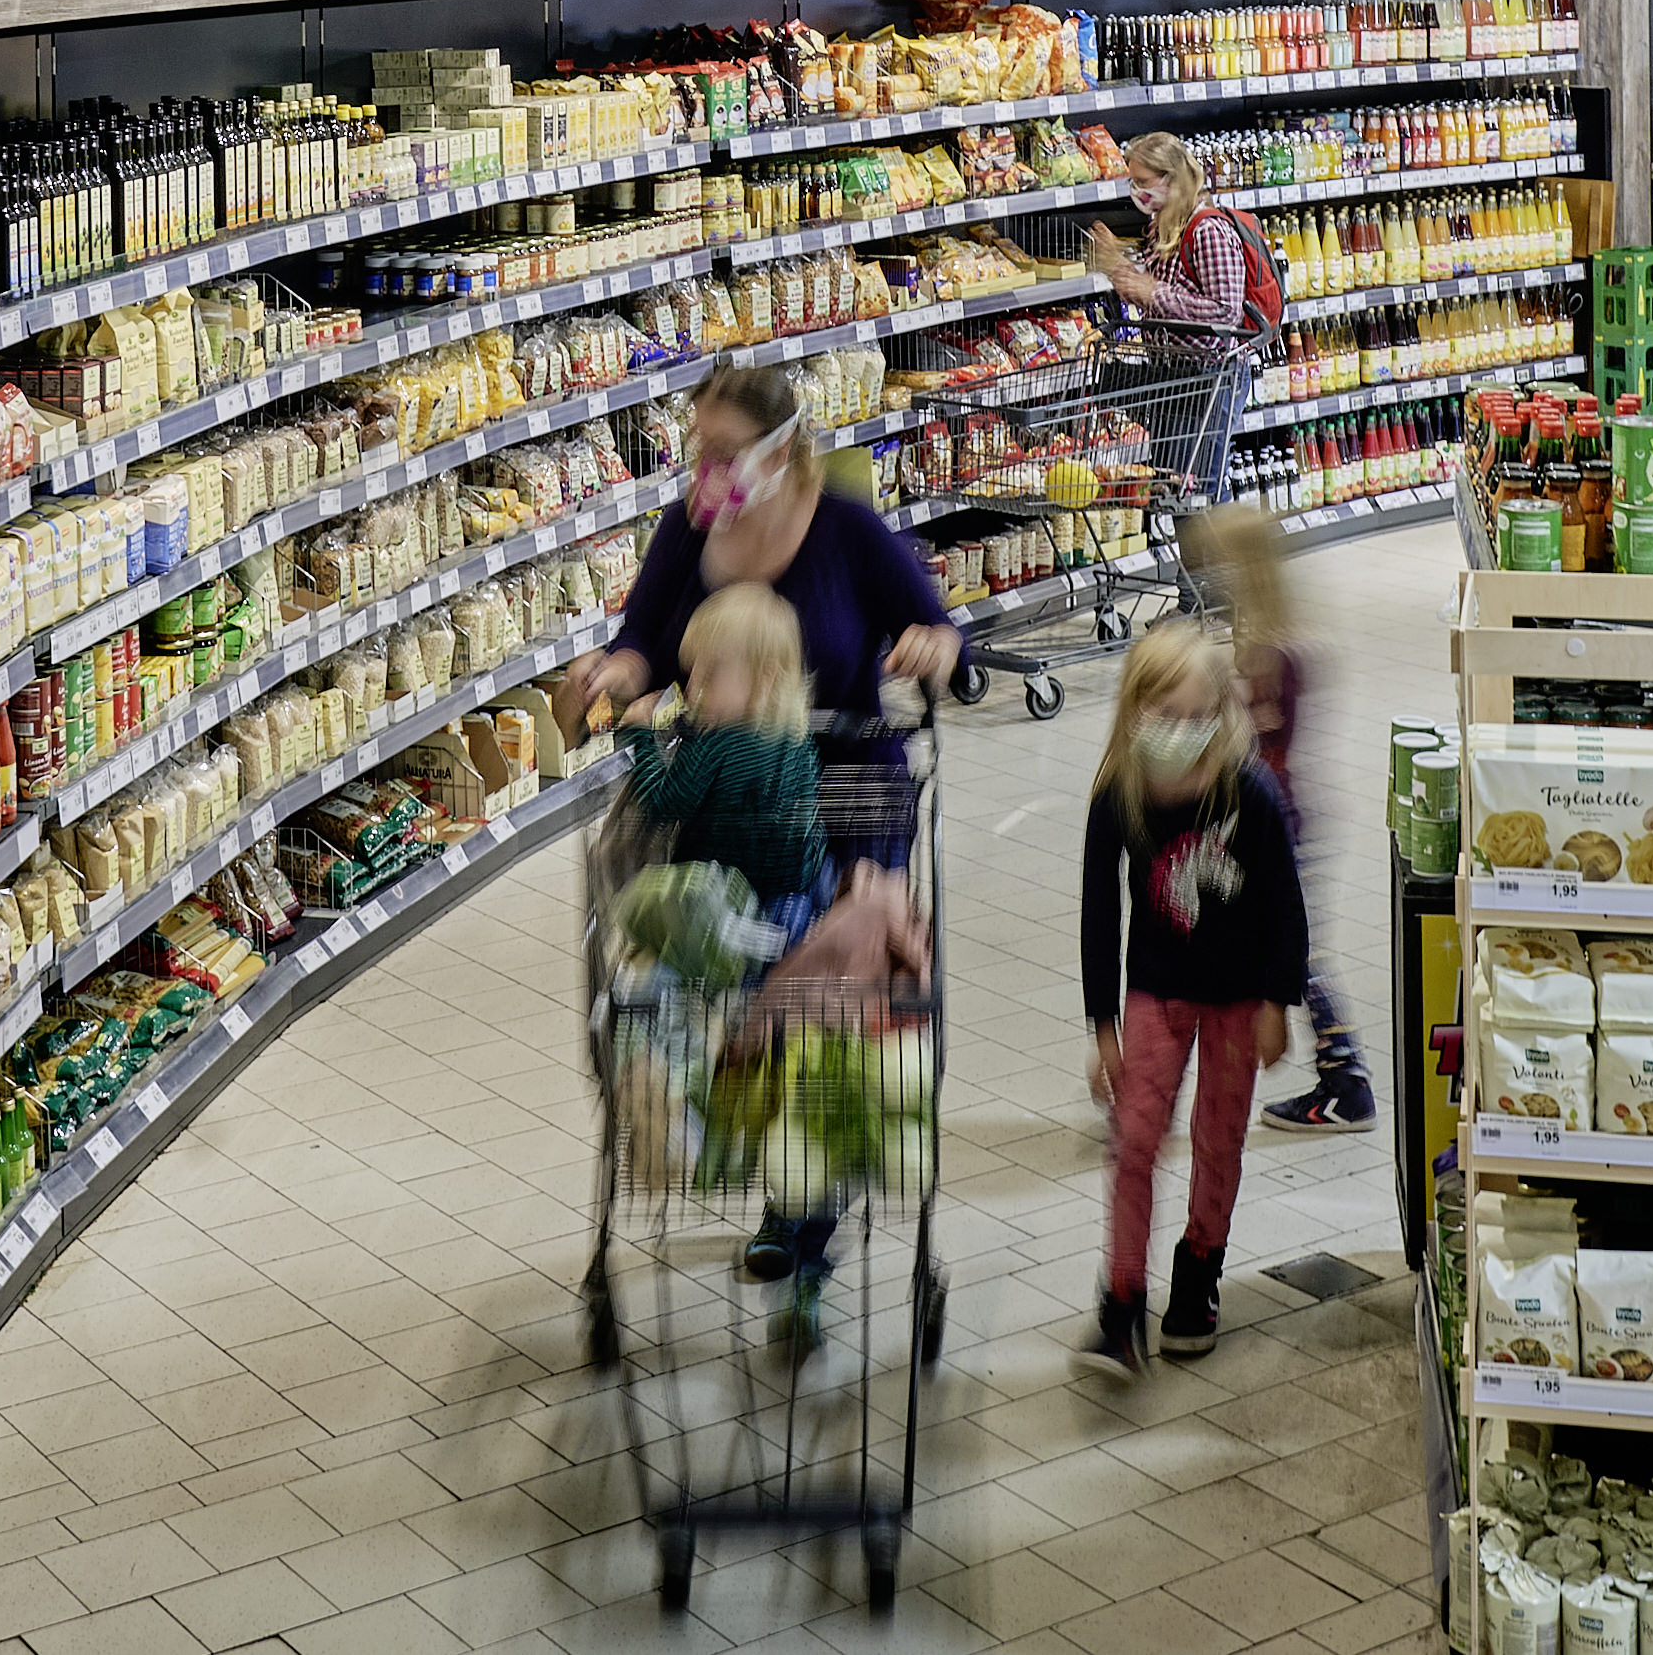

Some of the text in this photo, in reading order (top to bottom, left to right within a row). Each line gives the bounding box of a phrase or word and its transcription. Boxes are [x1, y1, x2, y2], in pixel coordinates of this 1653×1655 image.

[1541, 786, 1645, 810] Tagliatelle
[1552, 884, 1579, 899] 1,95
[1533, 1131, 1560, 1145] 1,95
[1534, 1379, 1561, 1393] 1,95
